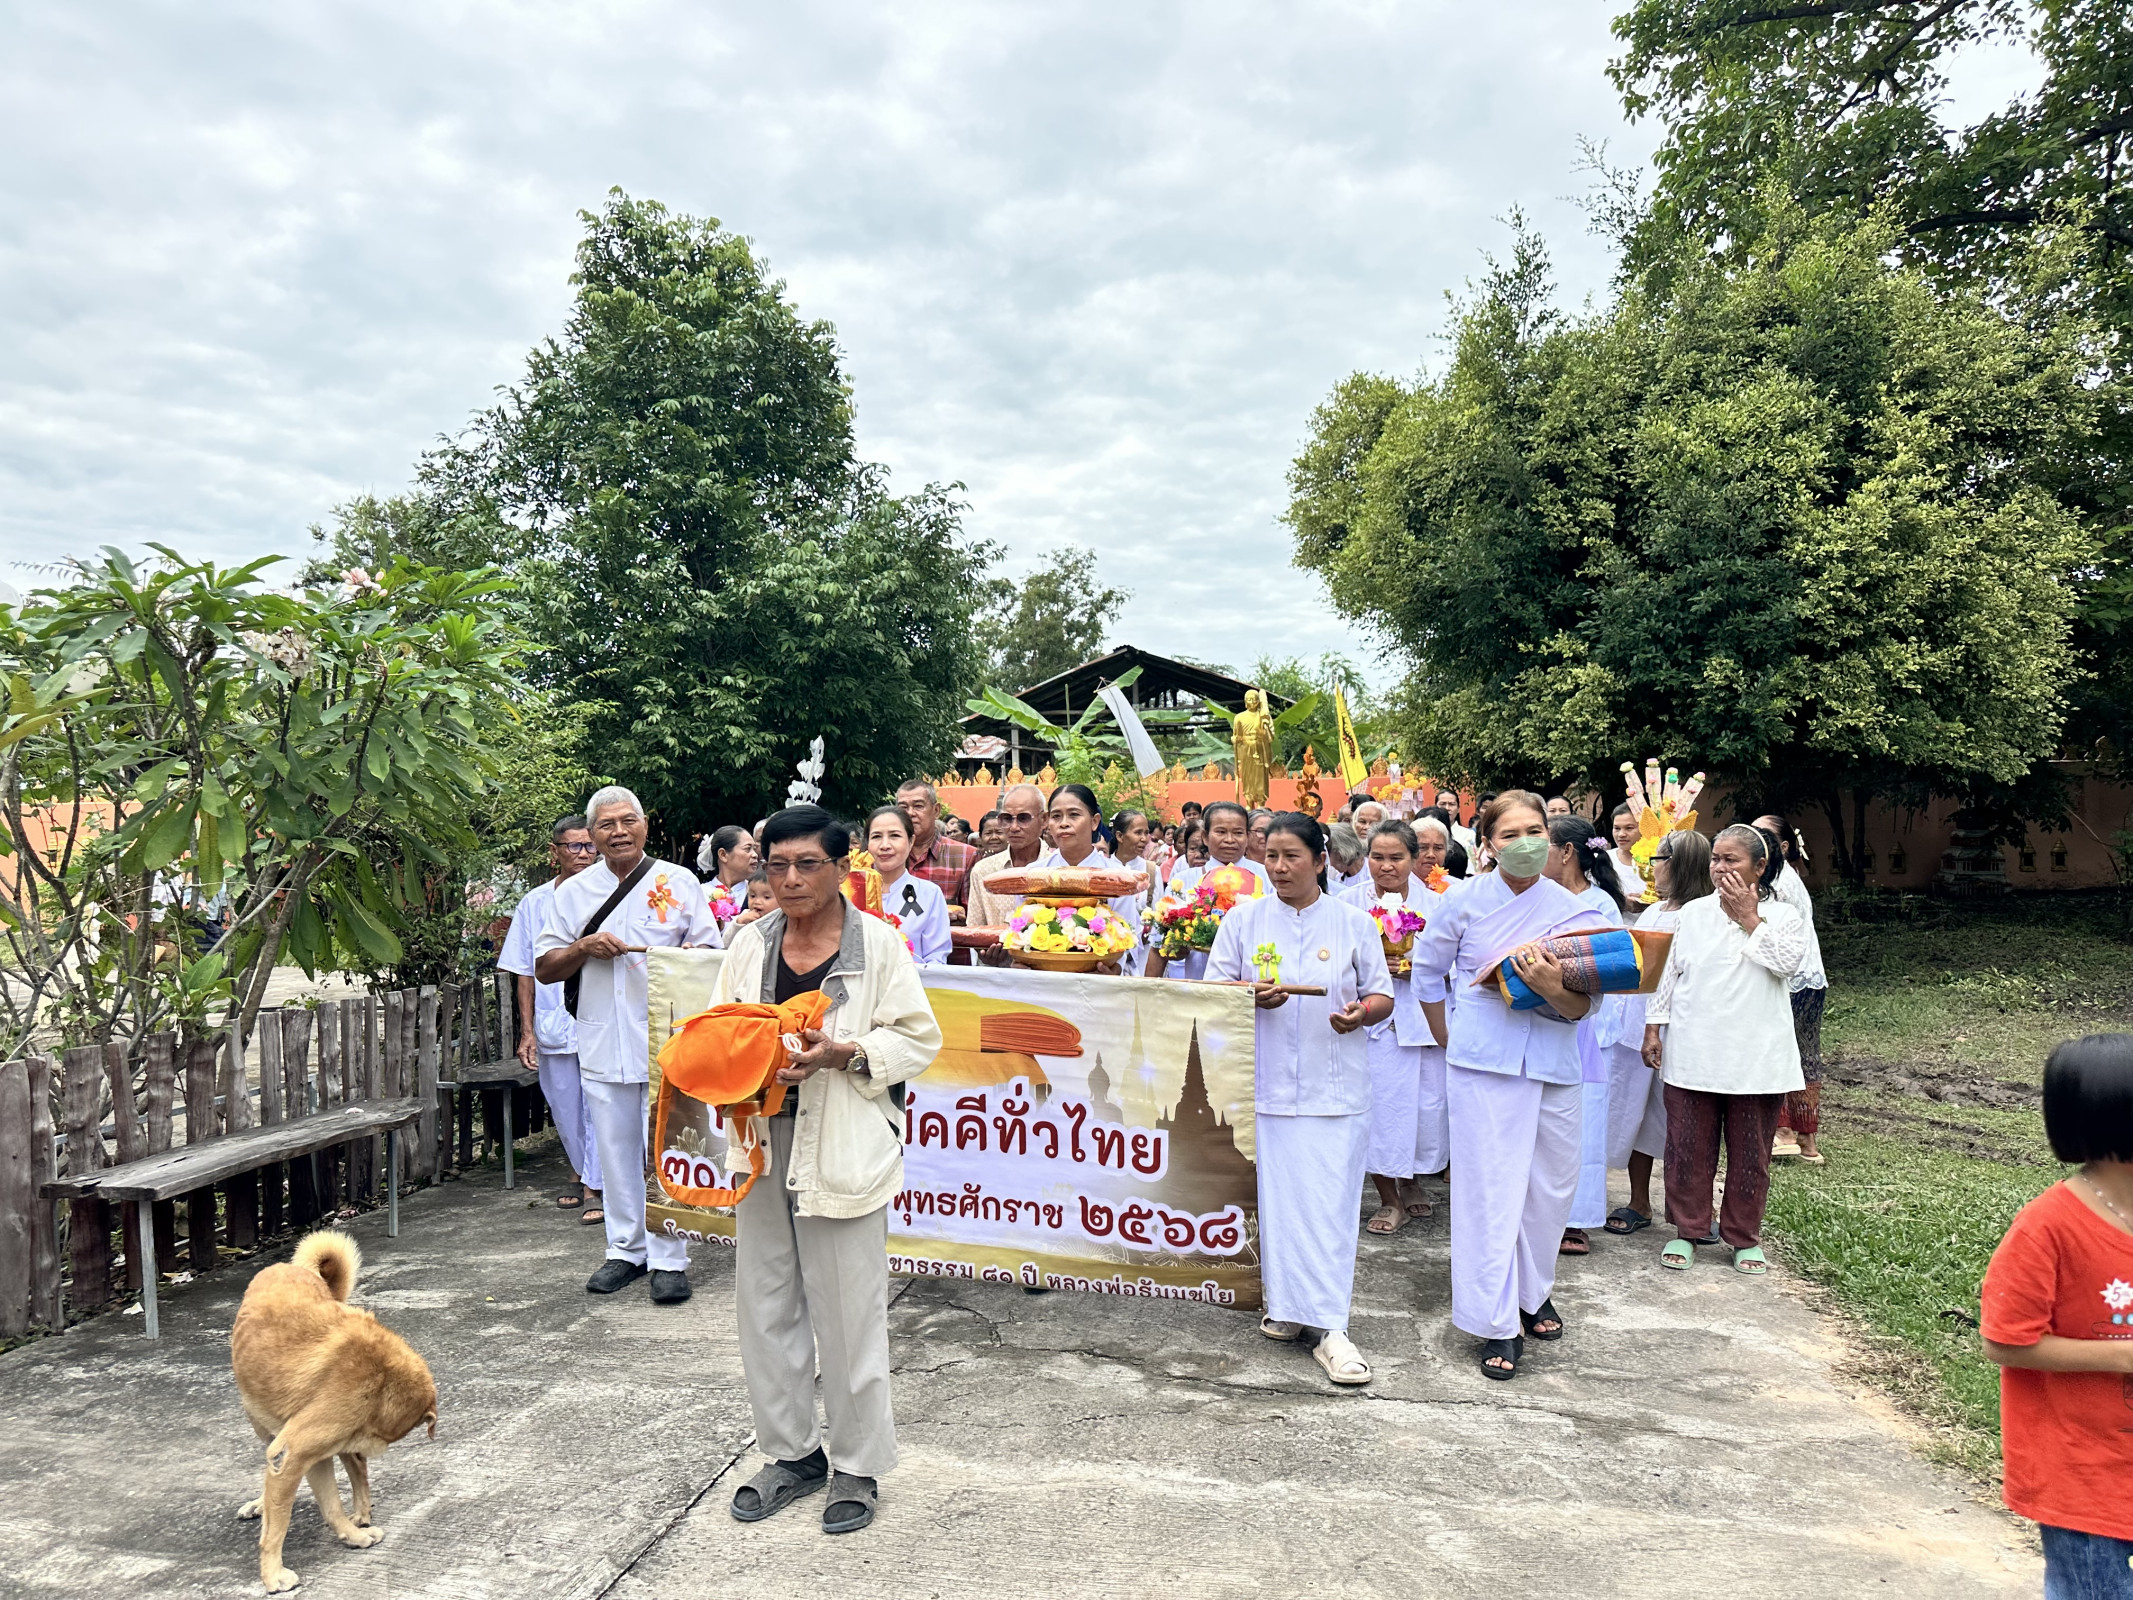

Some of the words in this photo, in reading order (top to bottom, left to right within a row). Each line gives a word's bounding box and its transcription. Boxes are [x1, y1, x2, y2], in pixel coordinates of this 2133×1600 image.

[1078, 1195, 1240, 1249] ๒๕๖๘
[889, 1256, 974, 1280] ชาธรรม
[982, 1267, 1014, 1284] ๘๑
[1022, 1264, 1037, 1287] ปี
